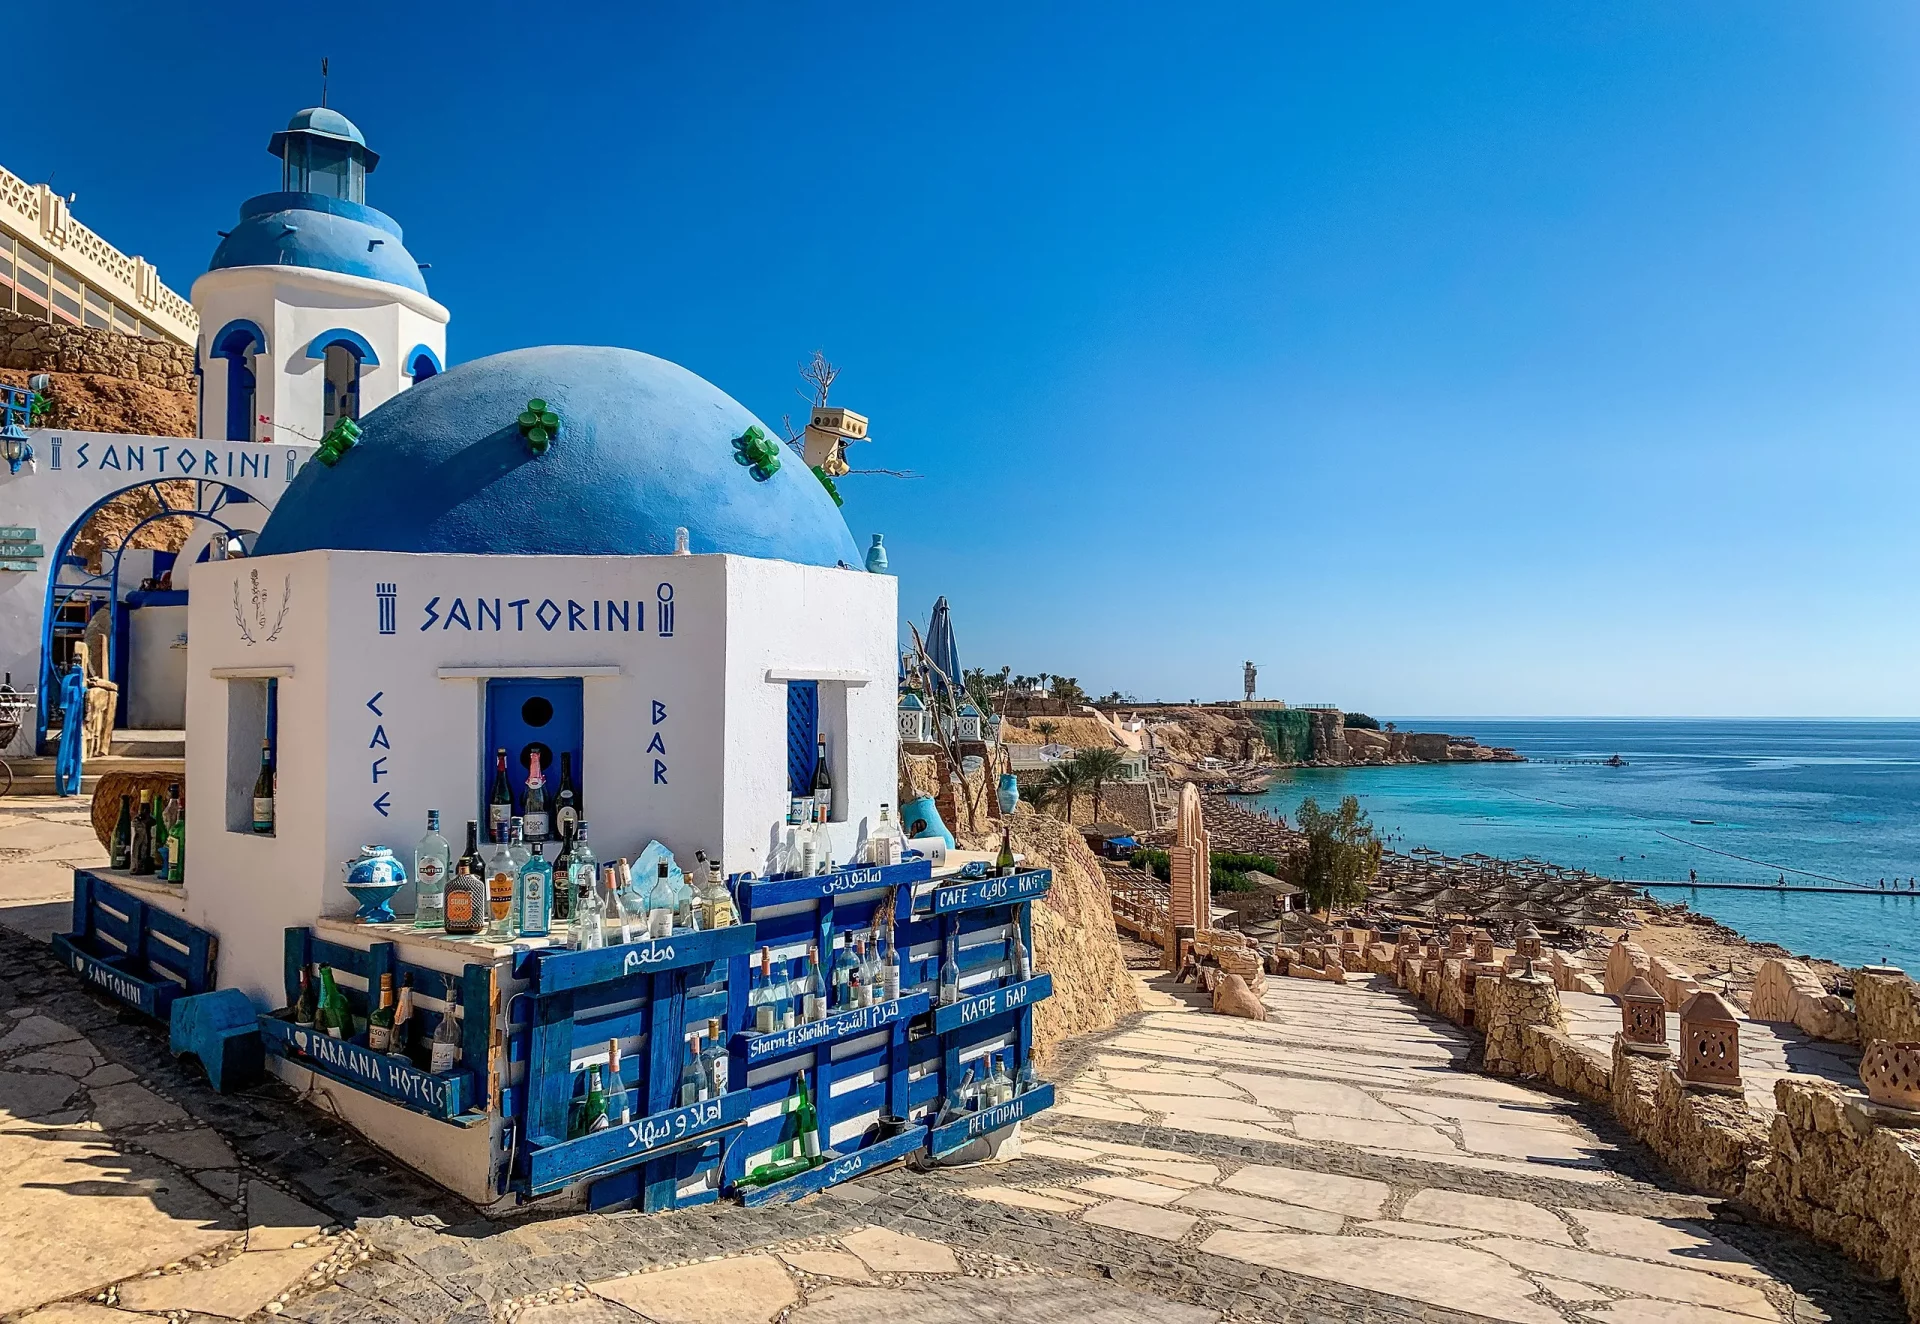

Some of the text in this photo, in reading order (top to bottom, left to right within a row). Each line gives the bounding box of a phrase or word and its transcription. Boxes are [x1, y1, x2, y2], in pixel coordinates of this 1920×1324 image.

[76, 441, 270, 479] SANTORINI
[420, 597, 645, 632] SANTORINI
[366, 691, 391, 818] CAFE
[646, 699, 668, 785] BAR
[940, 888, 969, 908] CAFE
[980, 878, 1008, 901] كافيه
[623, 941, 675, 976] مطعم
[88, 963, 141, 1005] SANTORINI
[838, 1008, 868, 1036] الشيخ
[872, 1001, 899, 1028] شرم
[961, 985, 1027, 1023] КАФЕ БАР
[312, 1035, 382, 1083] FARAANA
[388, 1065, 444, 1109] HOTELS
[969, 1100, 1024, 1135] РЕСТОРАН
